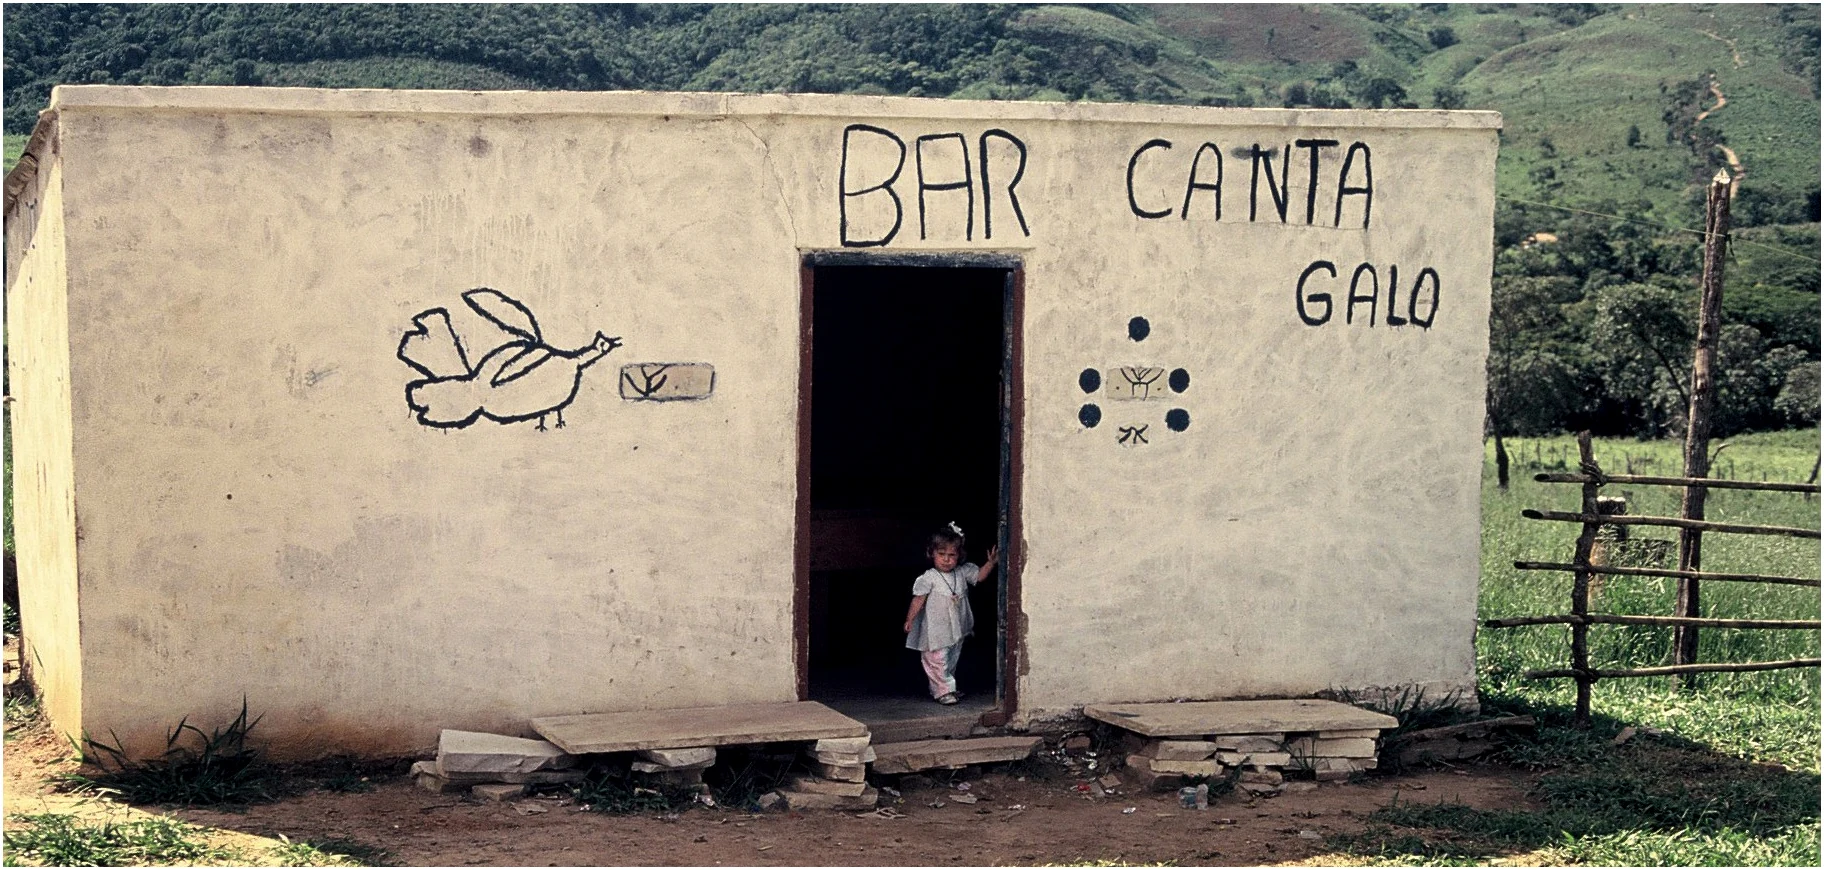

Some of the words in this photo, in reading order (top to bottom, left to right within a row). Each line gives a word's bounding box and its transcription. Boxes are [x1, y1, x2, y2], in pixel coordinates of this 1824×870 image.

[839, 124, 1030, 248] BAR
[1126, 137, 1374, 229] CANTA
[1296, 260, 1440, 328] GALO
